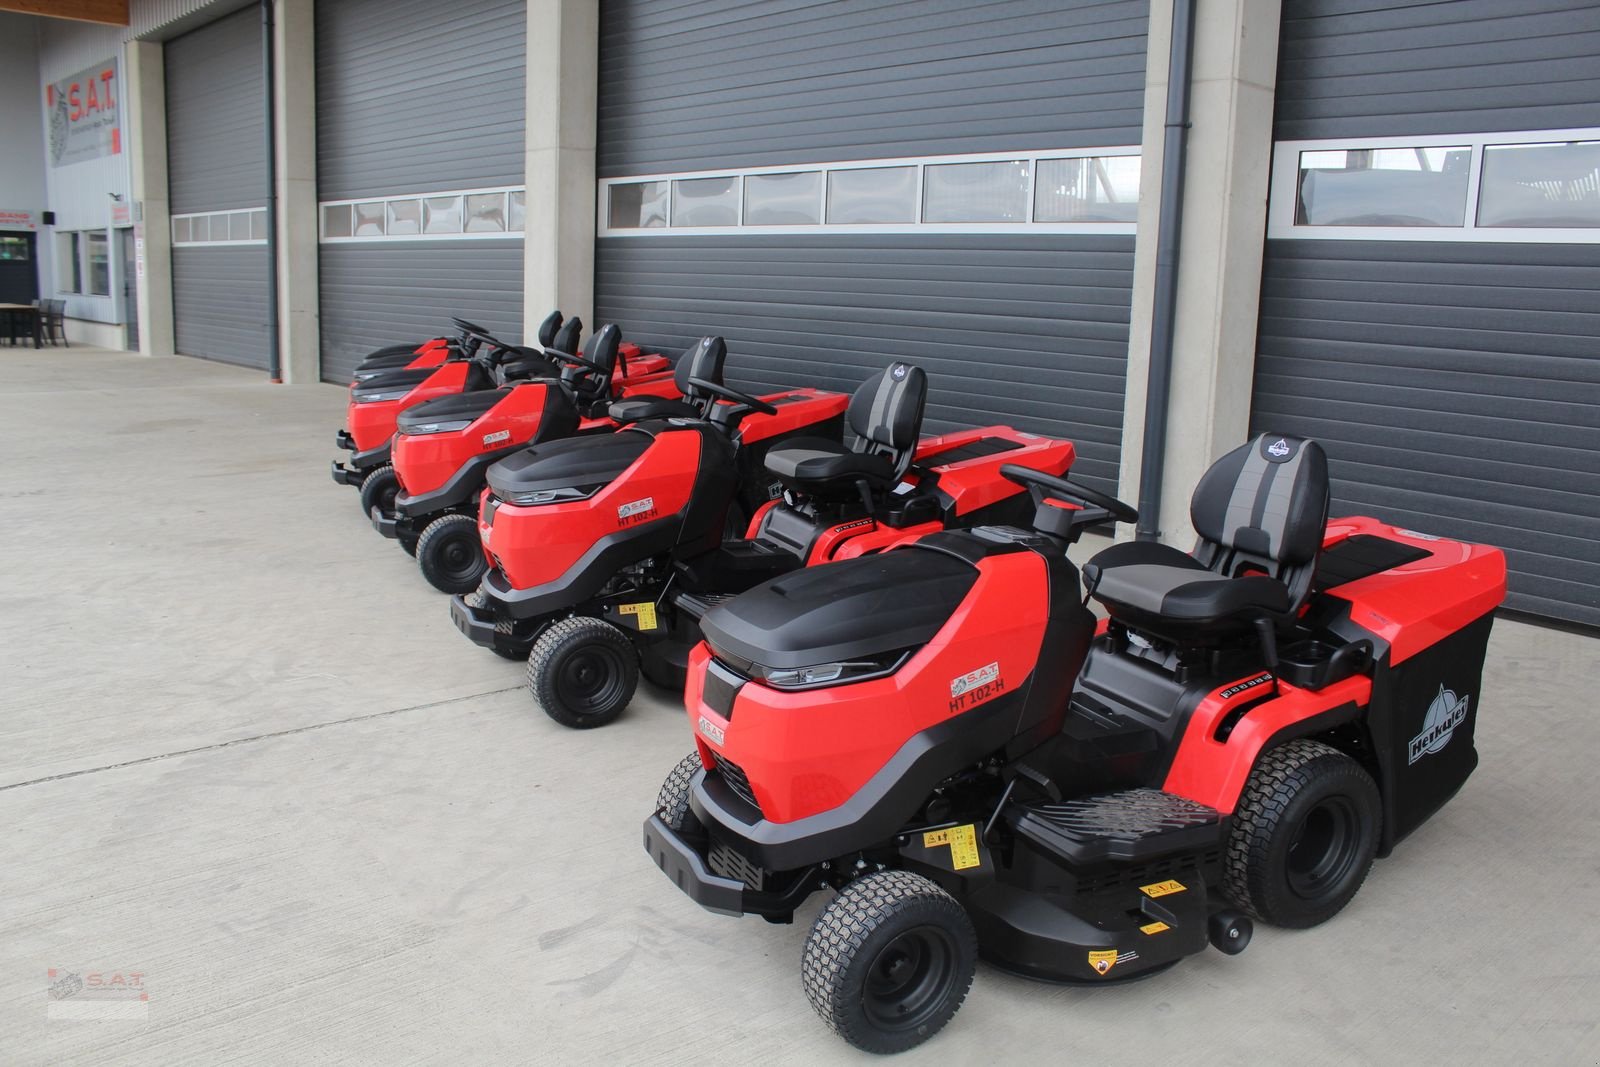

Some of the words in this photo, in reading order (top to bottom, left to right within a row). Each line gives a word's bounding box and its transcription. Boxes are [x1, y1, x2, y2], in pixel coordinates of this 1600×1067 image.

[69, 70, 115, 122] S.A.T.
[618, 516, 629, 527] HT
[632, 507, 658, 523] 102-H
[967, 664, 998, 683] S.A.T.
[949, 696, 965, 713] HT
[970, 678, 1004, 704] 102-H
[1411, 703, 1466, 757] Herkules
